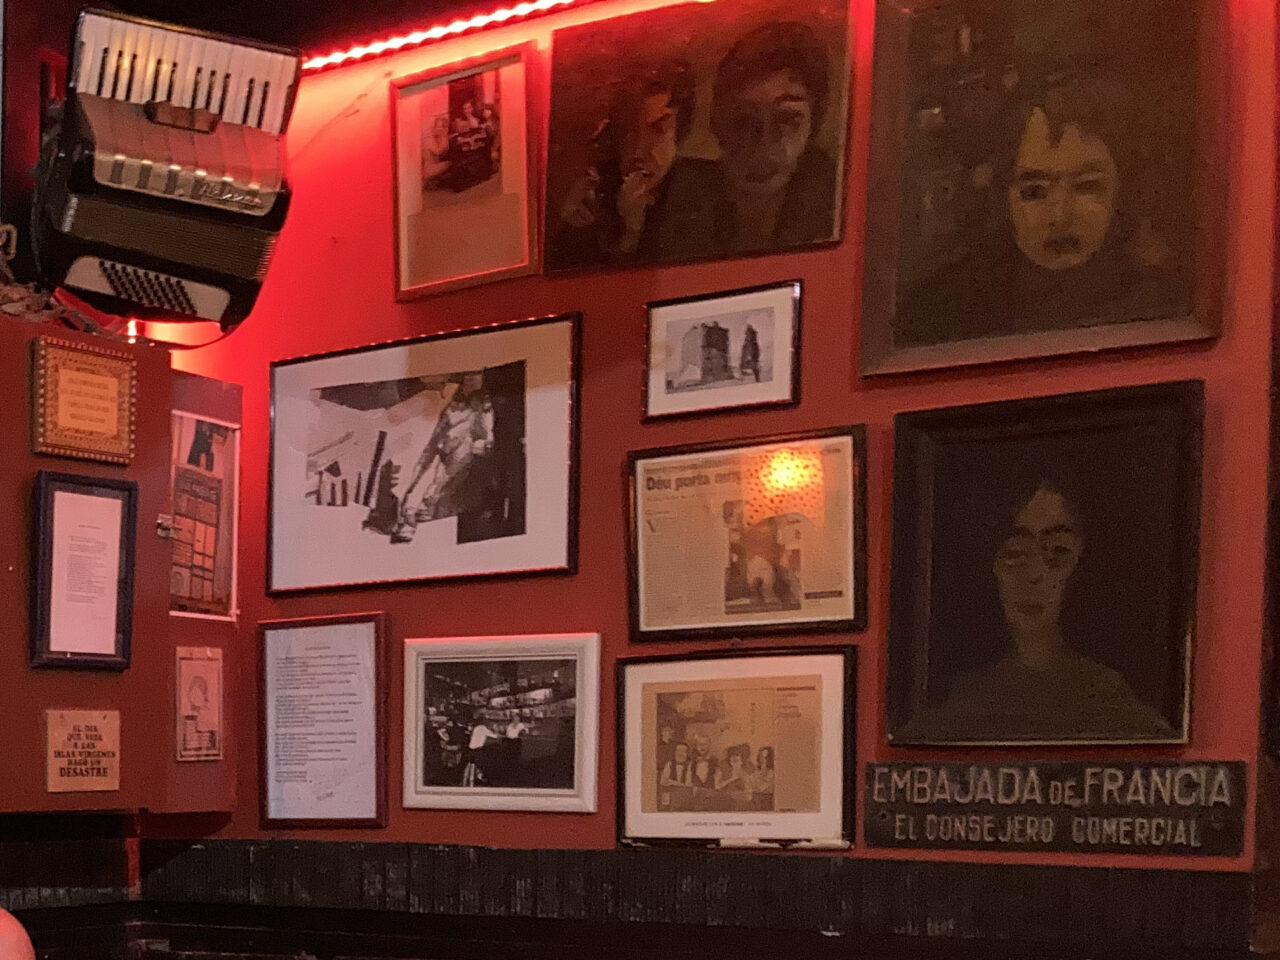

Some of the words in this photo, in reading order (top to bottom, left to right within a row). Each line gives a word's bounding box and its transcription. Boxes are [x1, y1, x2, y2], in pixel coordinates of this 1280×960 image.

[60, 767, 109, 777] DESASTRE
[873, 766, 1043, 804] EMBAJADA
[1049, 780, 1081, 807] DE
[1084, 766, 1231, 807] FRANCIA
[894, 814, 918, 841] EL
[926, 814, 1054, 843] CONSEJERO
[1073, 816, 1202, 847] COMERCIAL
